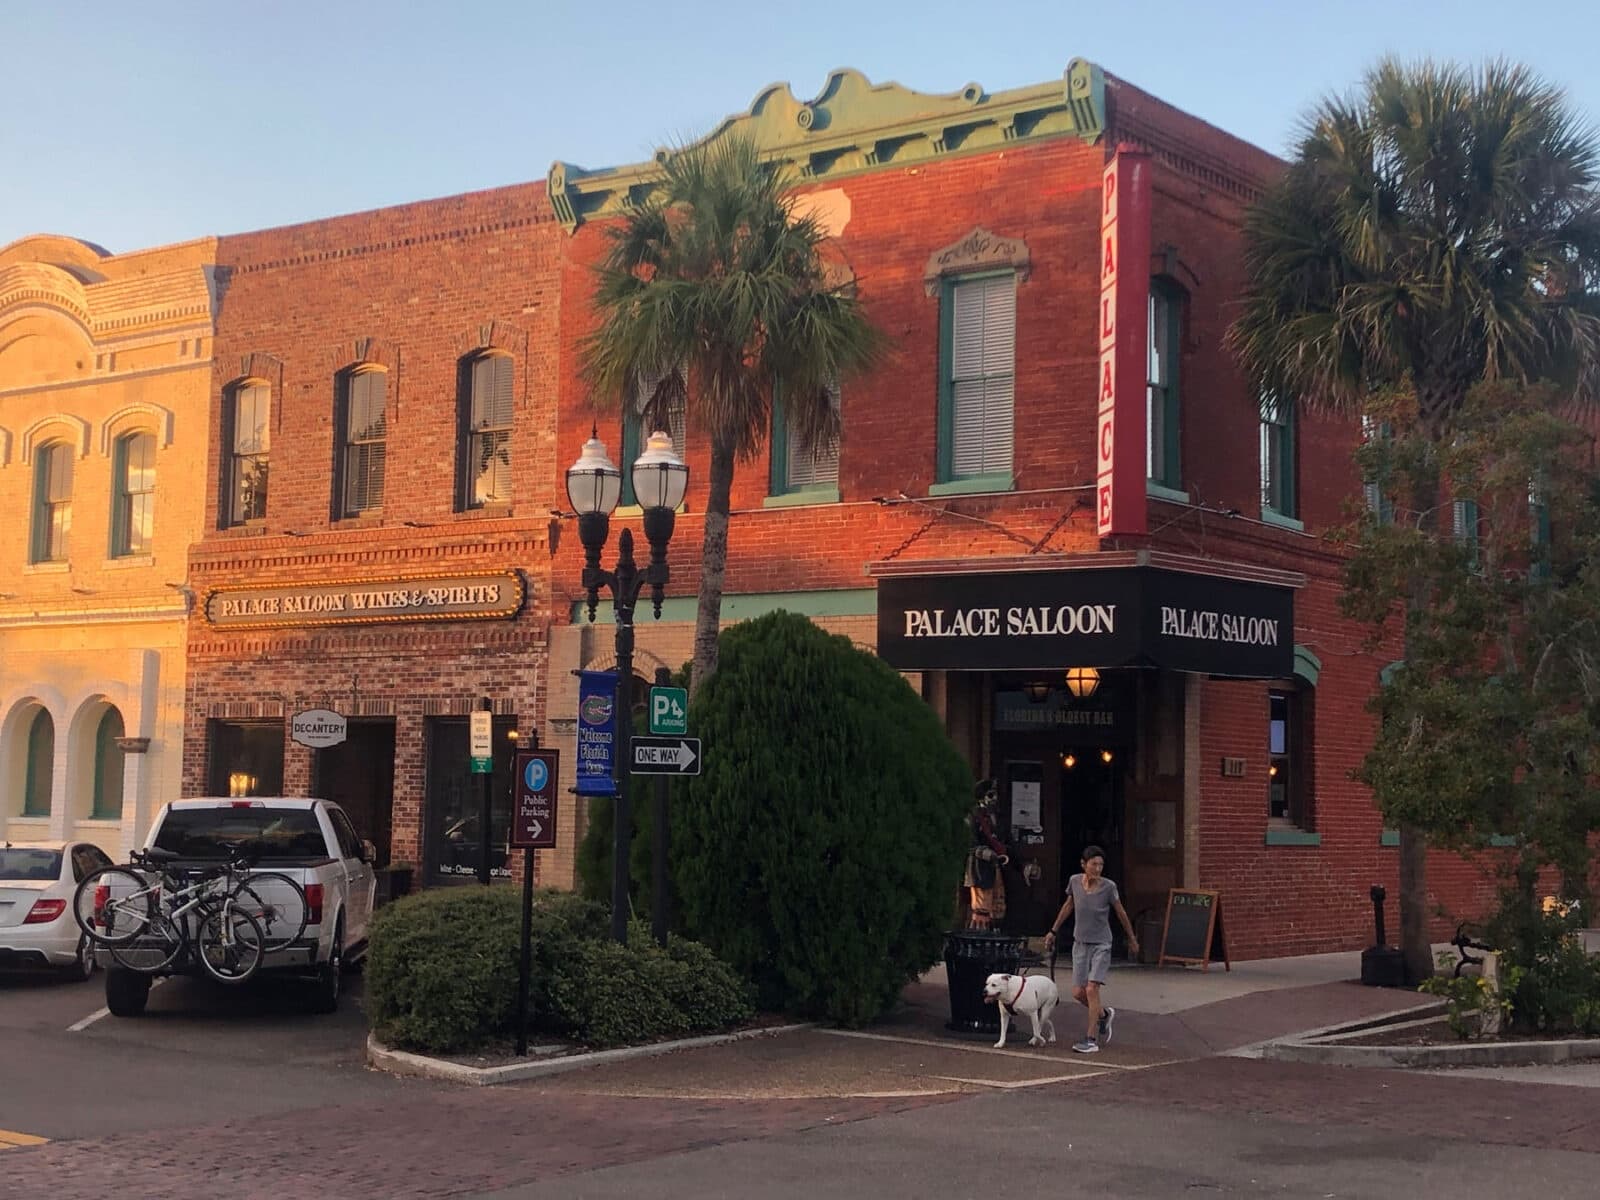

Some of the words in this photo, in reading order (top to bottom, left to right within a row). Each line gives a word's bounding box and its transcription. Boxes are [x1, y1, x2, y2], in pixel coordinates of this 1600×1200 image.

[1099, 171, 1116, 527] PALACE
[221, 597, 280, 617] PALACE
[284, 594, 346, 614] SALOON
[351, 589, 409, 609] WINES
[409, 588, 427, 607] &
[428, 584, 500, 606] SPIRITS
[904, 608, 1000, 637] PALACE
[1007, 605, 1116, 636] SALOON
[1161, 606, 1219, 640] PALACE
[1221, 613, 1279, 647] SALOON
[294, 723, 345, 734] DECANTERY
[579, 728, 613, 744] Welcome
[580, 744, 609, 760] Florida
[638, 749, 657, 762] ONE
[660, 749, 680, 763] WAY
[524, 795, 548, 806] Public
[520, 806, 550, 819] Parking
